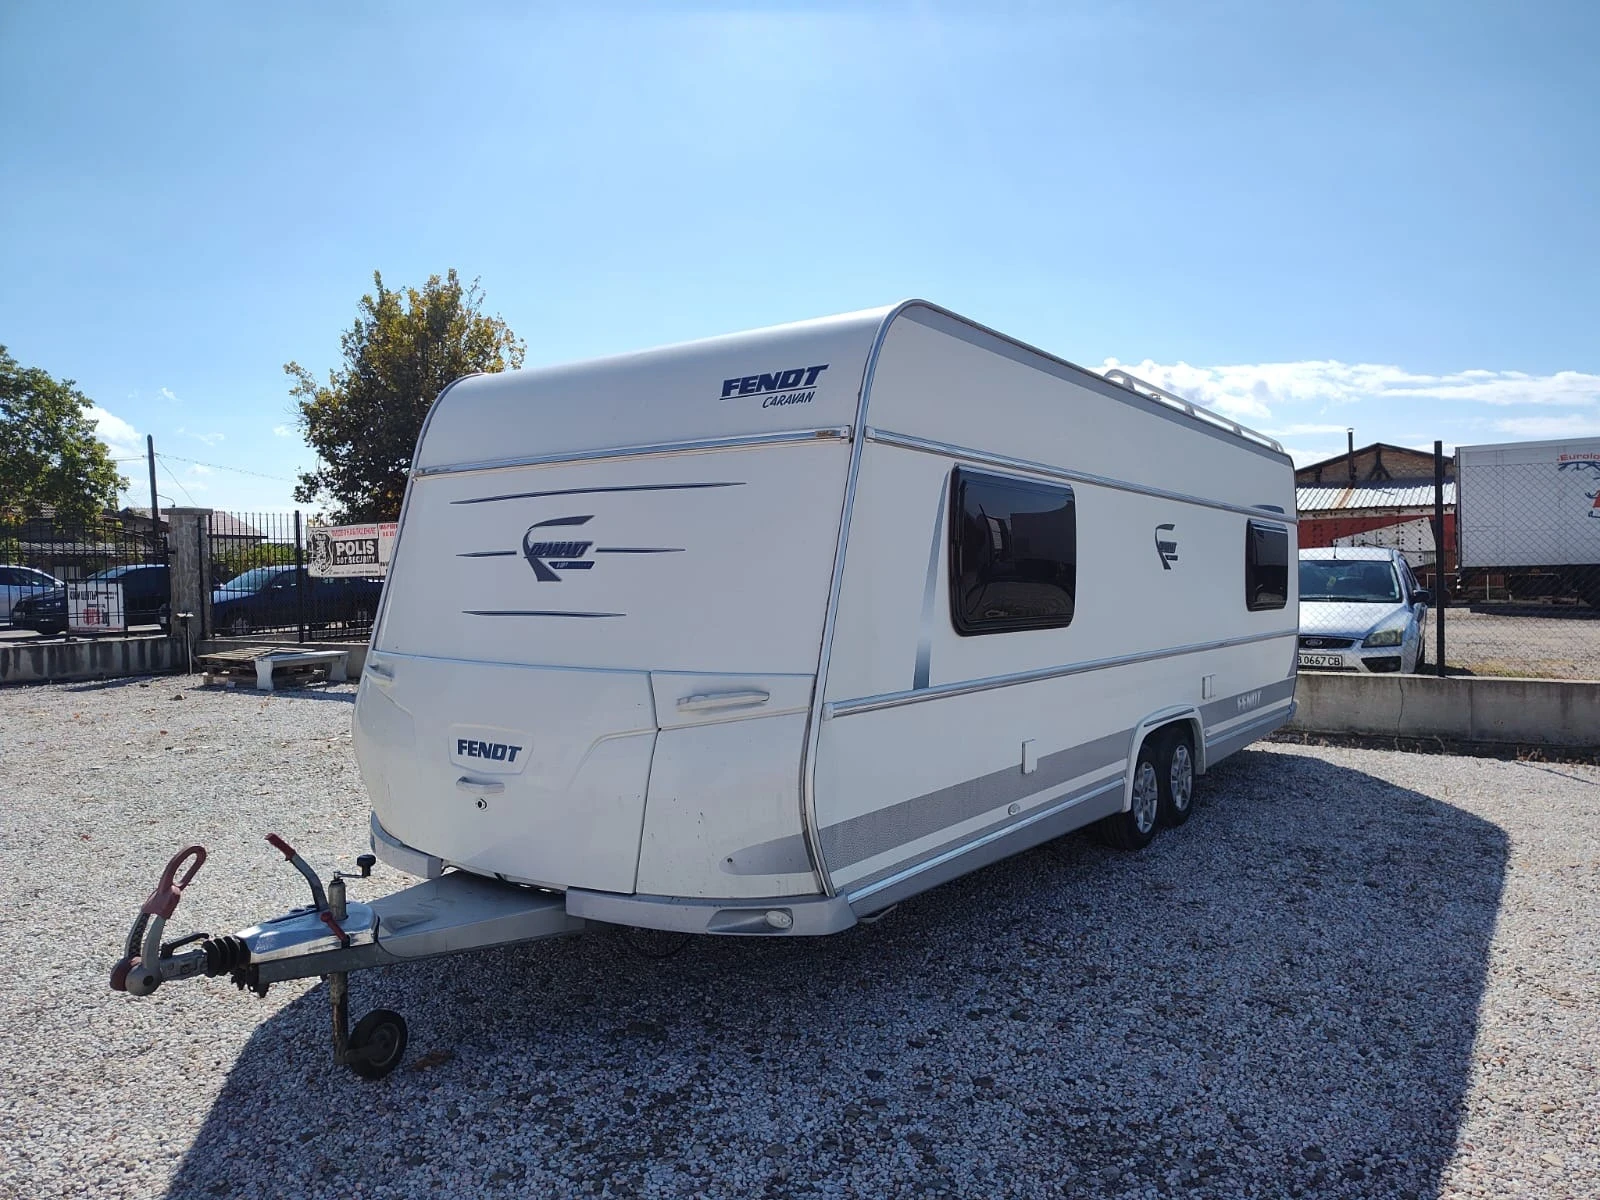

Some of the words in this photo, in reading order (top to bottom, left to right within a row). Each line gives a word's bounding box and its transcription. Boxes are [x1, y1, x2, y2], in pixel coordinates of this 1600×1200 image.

[721, 364, 829, 397] FENDT
[762, 391, 815, 408] CARAVAN
[335, 540, 375, 556] POLIS
[1304, 656, 1326, 665] 0667
[1328, 657, 1340, 665] CB
[1237, 690, 1262, 711] FENDT
[457, 739, 523, 762] FENDT
